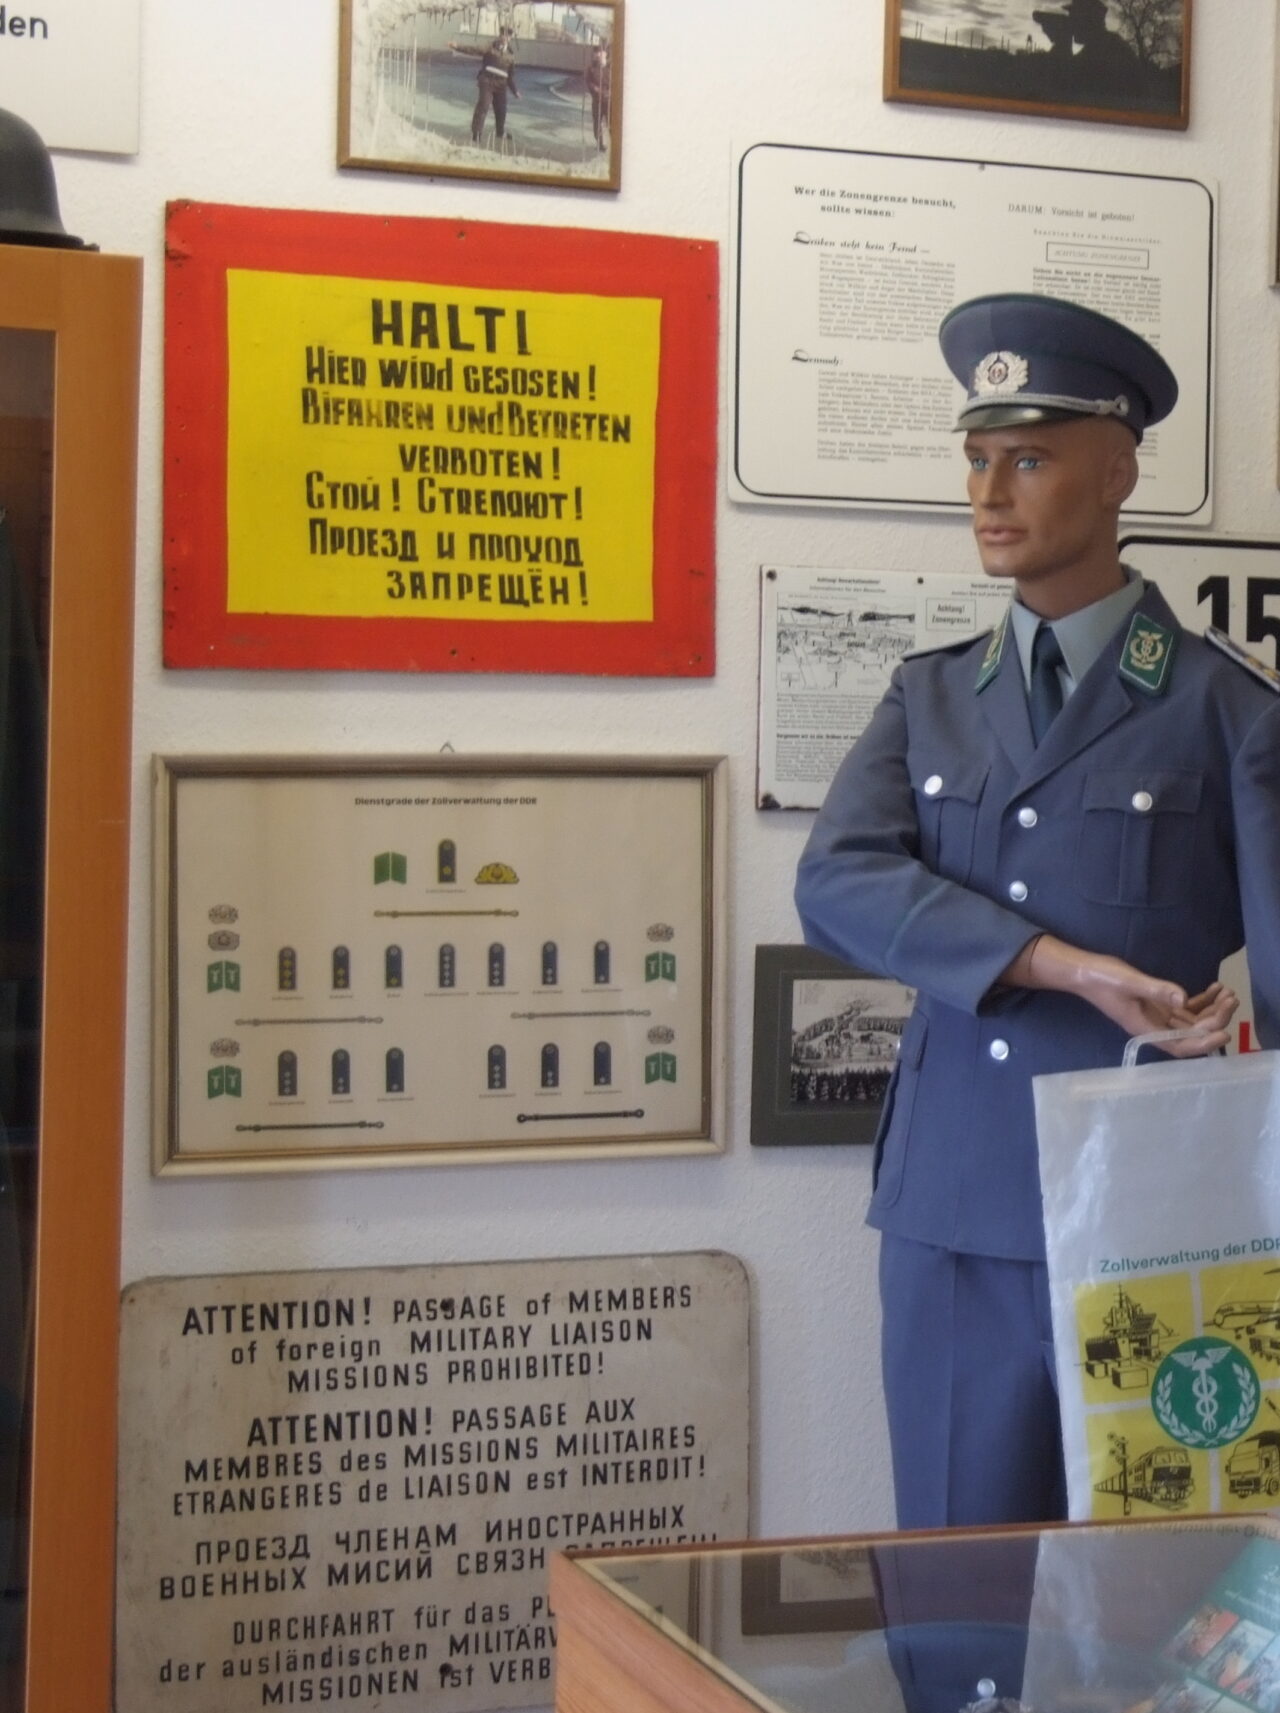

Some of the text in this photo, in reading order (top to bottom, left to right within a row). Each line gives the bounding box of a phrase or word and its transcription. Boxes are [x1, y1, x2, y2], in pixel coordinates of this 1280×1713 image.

[794, 186, 816, 196] Wer
[819, 188, 836, 198] die
[840, 189, 908, 204] Zonengrenze
[820, 204, 850, 214] sollte
[1051, 206, 1084, 218] Vorsicht
[371, 298, 532, 356] HALT!
[1099, 1248, 1221, 1274] Zollverwaltung
[1223, 1242, 1247, 1258] der
[182, 1284, 692, 1336] ATTENTION! PASSAGE of MEMBERS
[230, 1318, 653, 1366] of foreign MILITARY LIAISON
[287, 1351, 604, 1394] MISSIONS PROHIBITED!
[246, 1397, 637, 1448] ATTENTION! PASSAGE AUX
[185, 1424, 696, 1485] MEMBRES des MISSIONS MILITAIRES
[173, 1455, 707, 1517] ETRANGERES de LIAISON est INTERDIT!
[195, 1533, 311, 1566] ПРОЕЗД
[335, 1522, 458, 1554] ЧЛЕНАМ
[485, 1504, 686, 1543] ИНОСТРАННЫХ
[159, 1566, 308, 1601] ВОЕННЫХ
[327, 1549, 434, 1588] МИСИЙ
[233, 1608, 396, 1646] DURCHFAHRT
[413, 1604, 452, 1630] für
[465, 1601, 511, 1626] das
[159, 1657, 207, 1683] der
[221, 1640, 429, 1678] ausländischen
[261, 1668, 421, 1706] MISSIONEN
[489, 1656, 551, 1685] VERB
